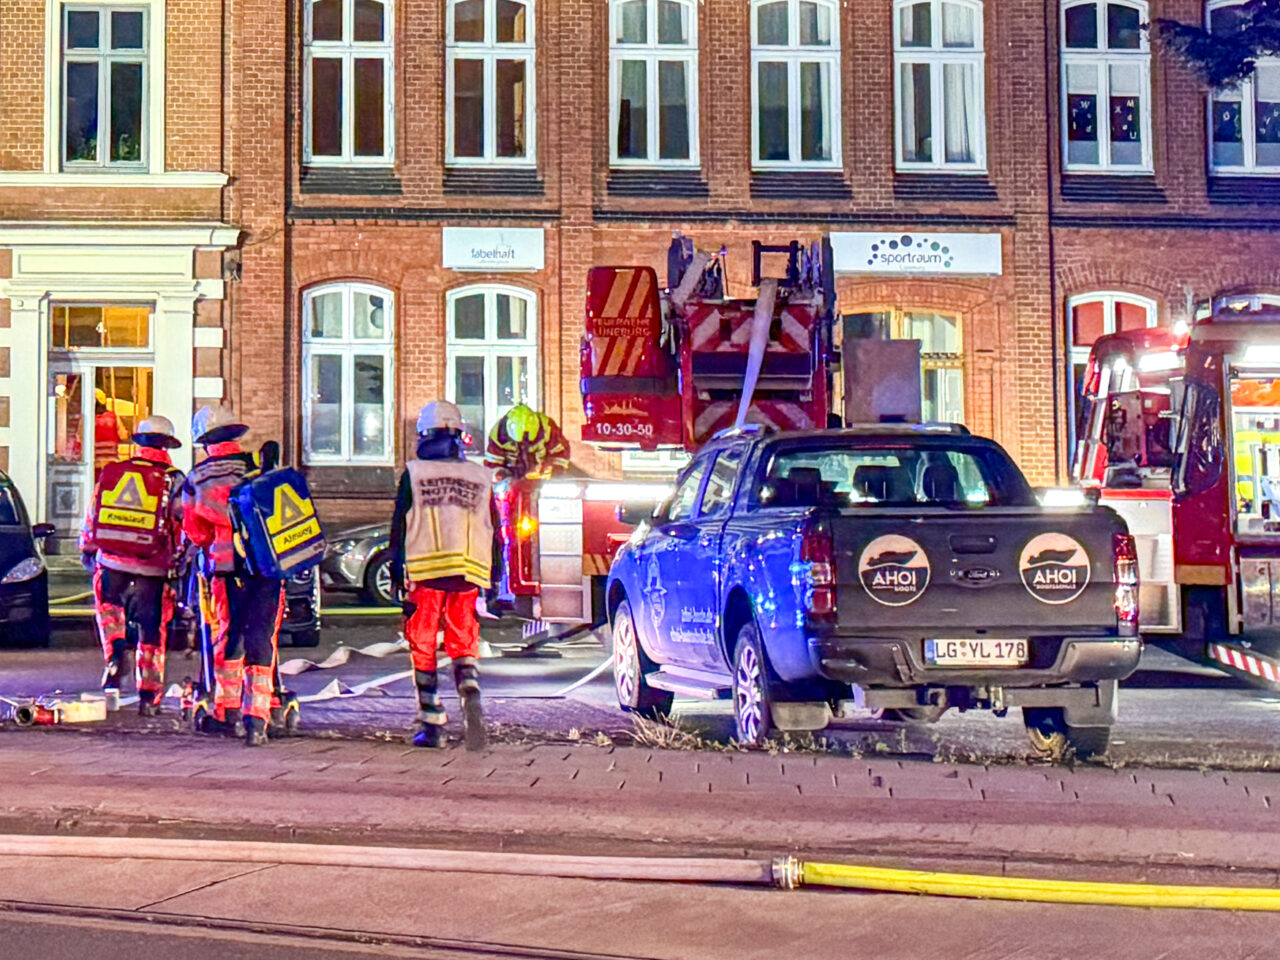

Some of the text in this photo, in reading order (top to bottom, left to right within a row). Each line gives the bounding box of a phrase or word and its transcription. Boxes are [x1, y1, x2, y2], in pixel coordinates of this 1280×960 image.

[471, 248, 515, 259] fabelhaft
[880, 252, 942, 265] sportraum
[596, 423, 654, 436] 10-30-50
[872, 571, 916, 585] AHOI
[1033, 569, 1077, 584] AHOI
[935, 642, 1025, 658] LG YL 178
